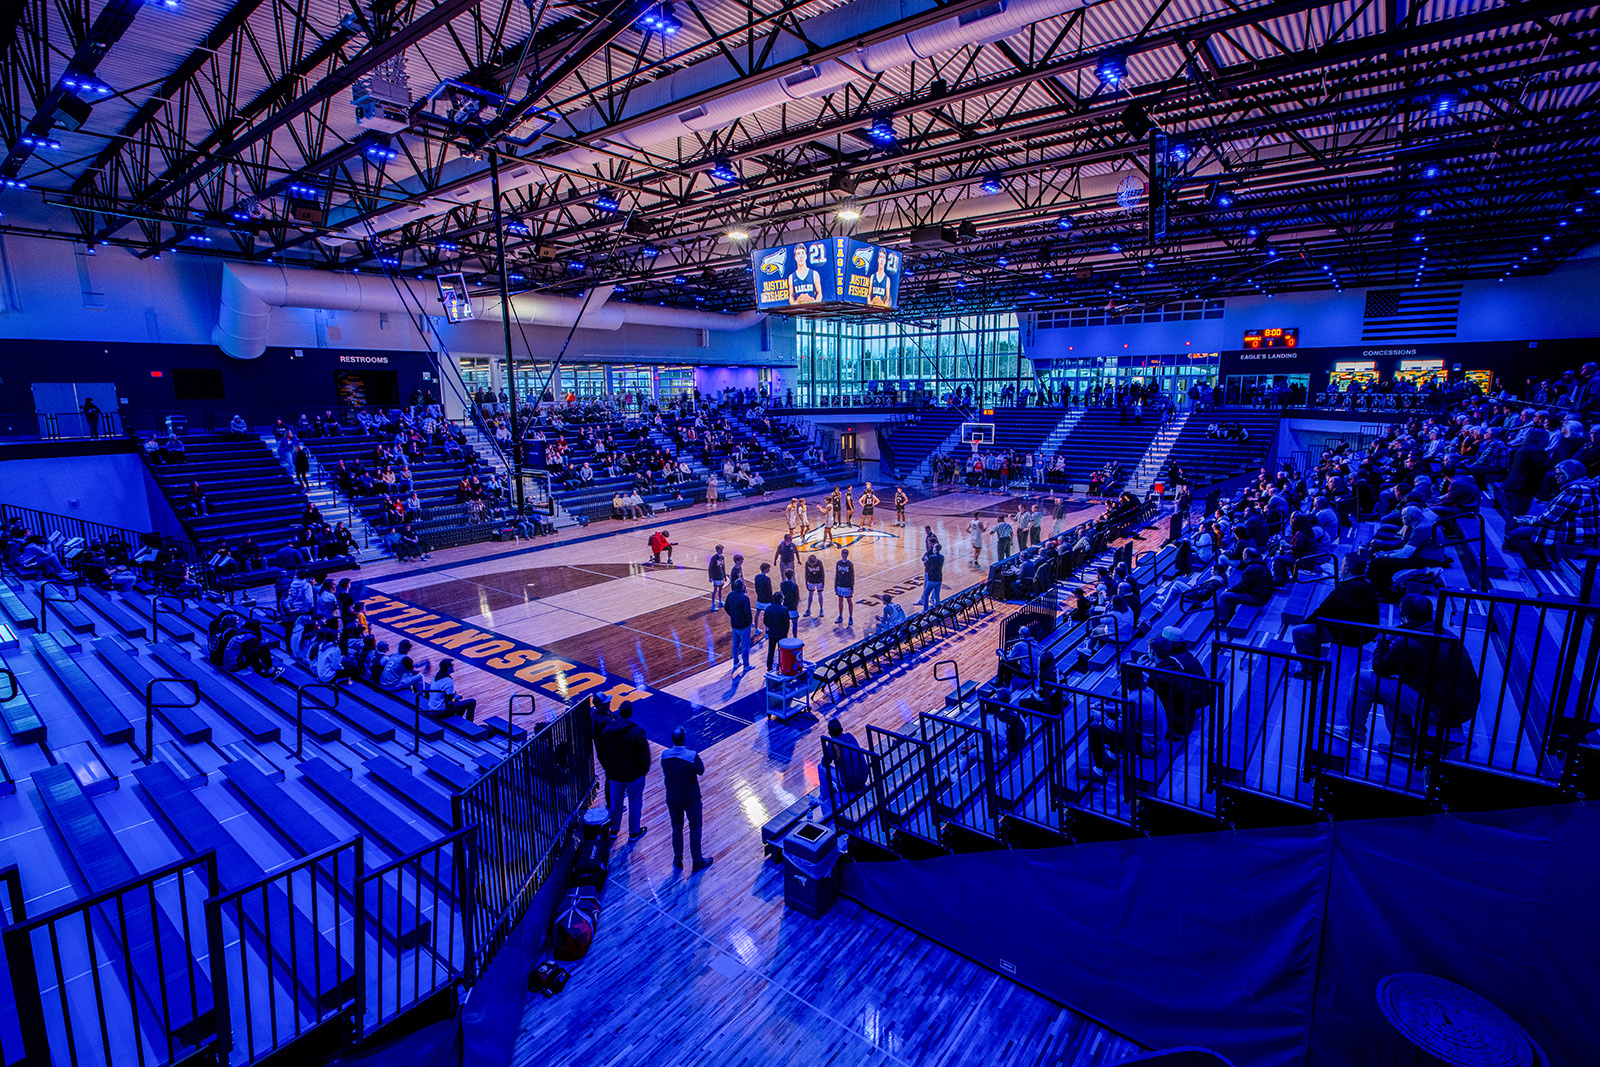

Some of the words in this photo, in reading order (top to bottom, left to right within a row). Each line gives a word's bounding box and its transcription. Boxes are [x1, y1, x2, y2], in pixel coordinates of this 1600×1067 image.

[810, 244, 827, 264] 21
[762, 279, 788, 292] JUSTIN
[850, 274, 870, 288] JUSTIN
[848, 284, 869, 298] FISHER
[1264, 328, 1281, 337] 8:00
[340, 355, 389, 363] RESTROOMS
[1362, 349, 1417, 357] CONCESSIONS
